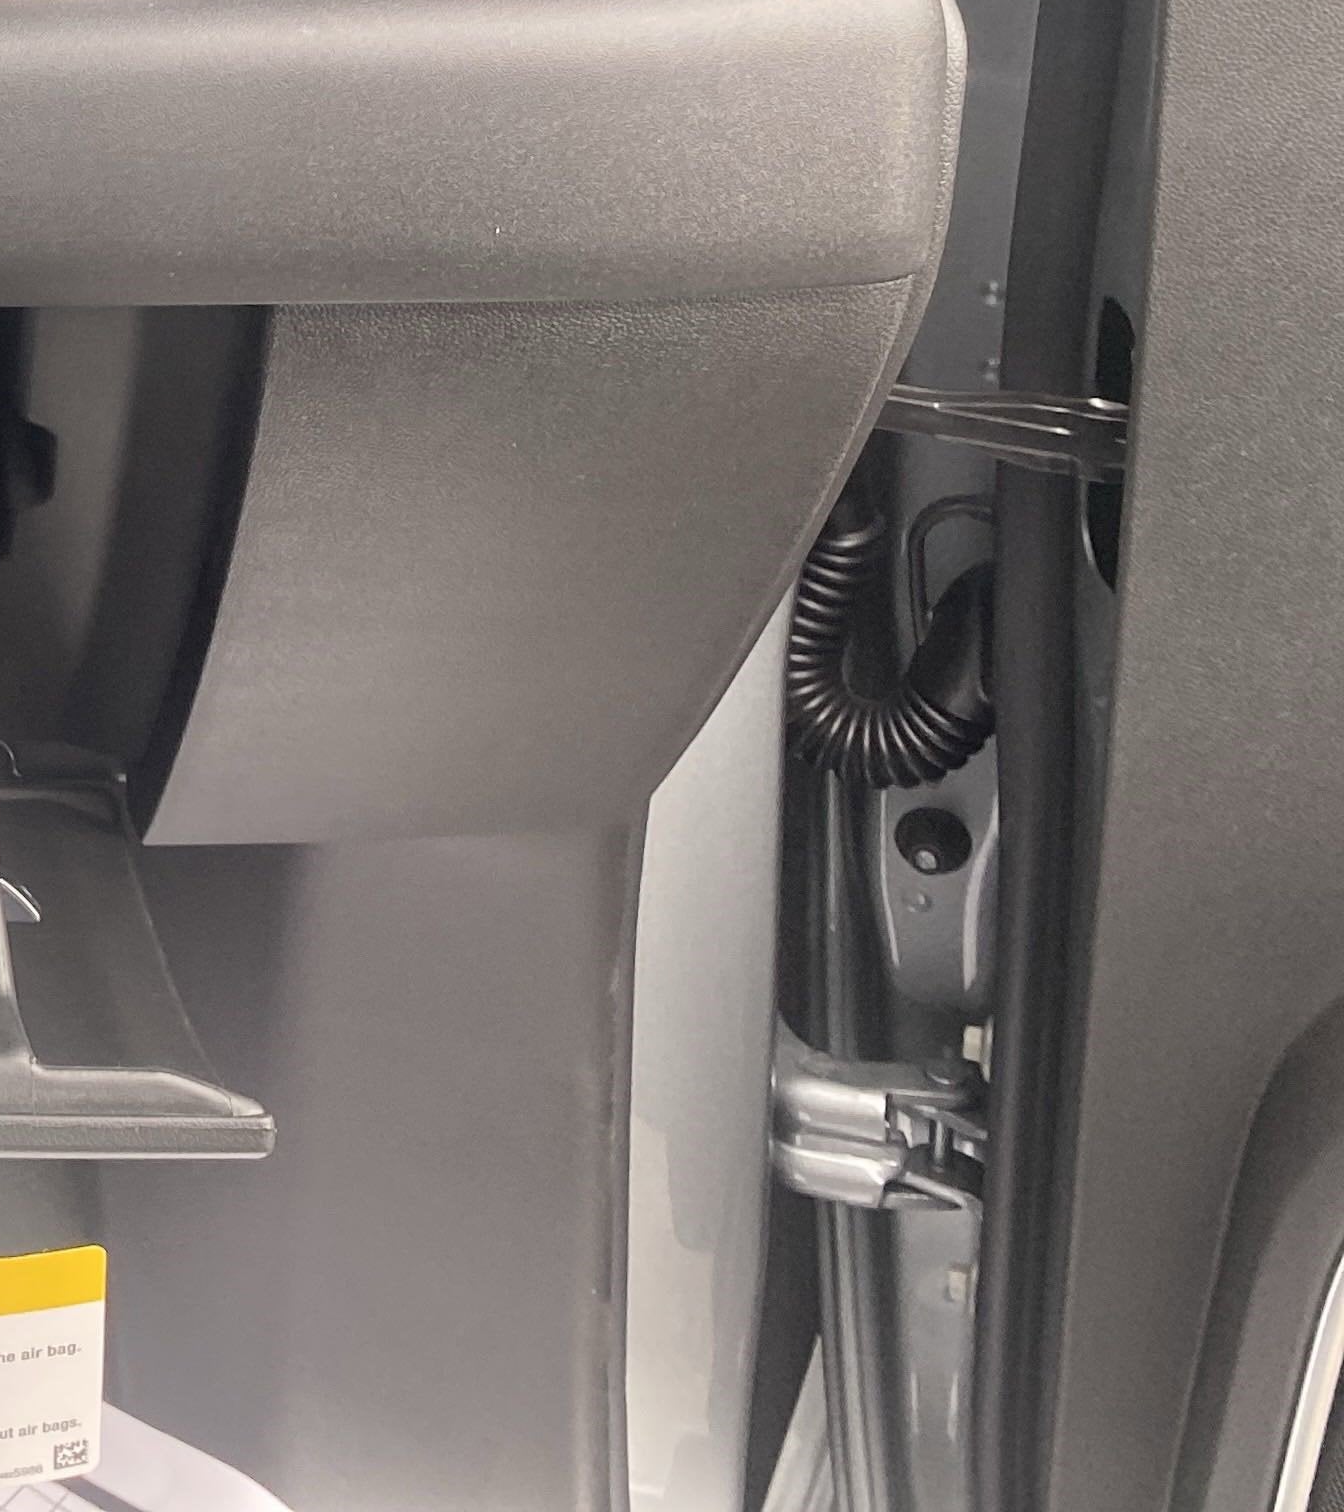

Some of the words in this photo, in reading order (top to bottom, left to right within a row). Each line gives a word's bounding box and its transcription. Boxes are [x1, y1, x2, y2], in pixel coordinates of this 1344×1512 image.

[21, 1347, 43, 1361] air
[47, 1341, 82, 1358] bag.
[18, 1424, 38, 1437] air
[42, 1417, 82, 1436] bags.
